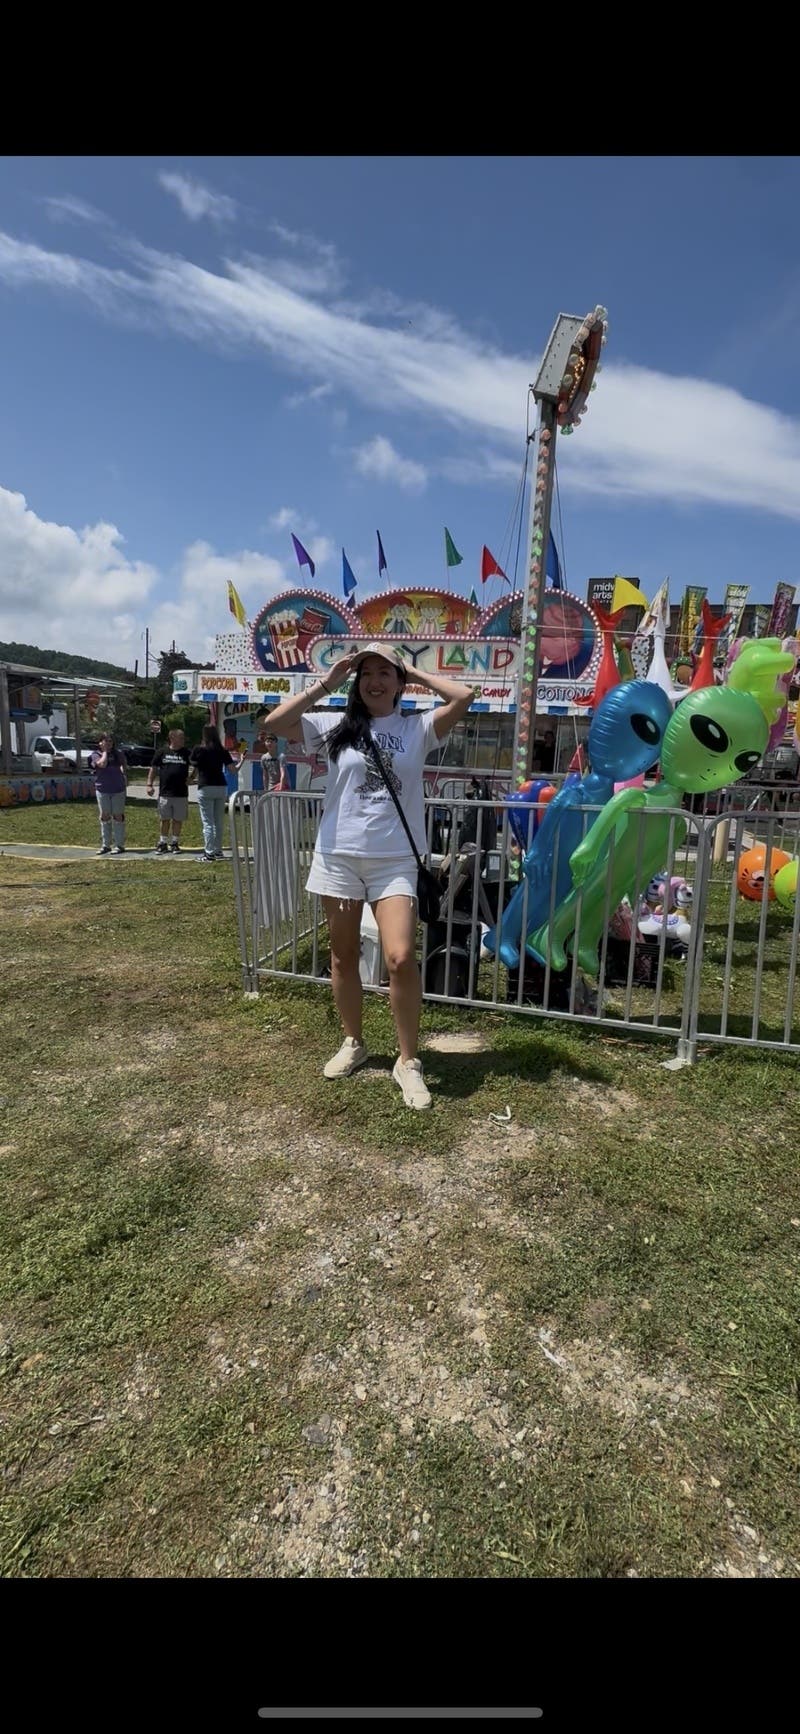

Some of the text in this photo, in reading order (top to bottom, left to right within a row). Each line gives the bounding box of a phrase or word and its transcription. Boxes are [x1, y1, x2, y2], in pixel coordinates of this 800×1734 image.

[592, 591, 613, 599] arts
[437, 643, 514, 671] LAND
[201, 677, 291, 692] POPCORN NACHOS
[483, 687, 511, 697] CANDY
